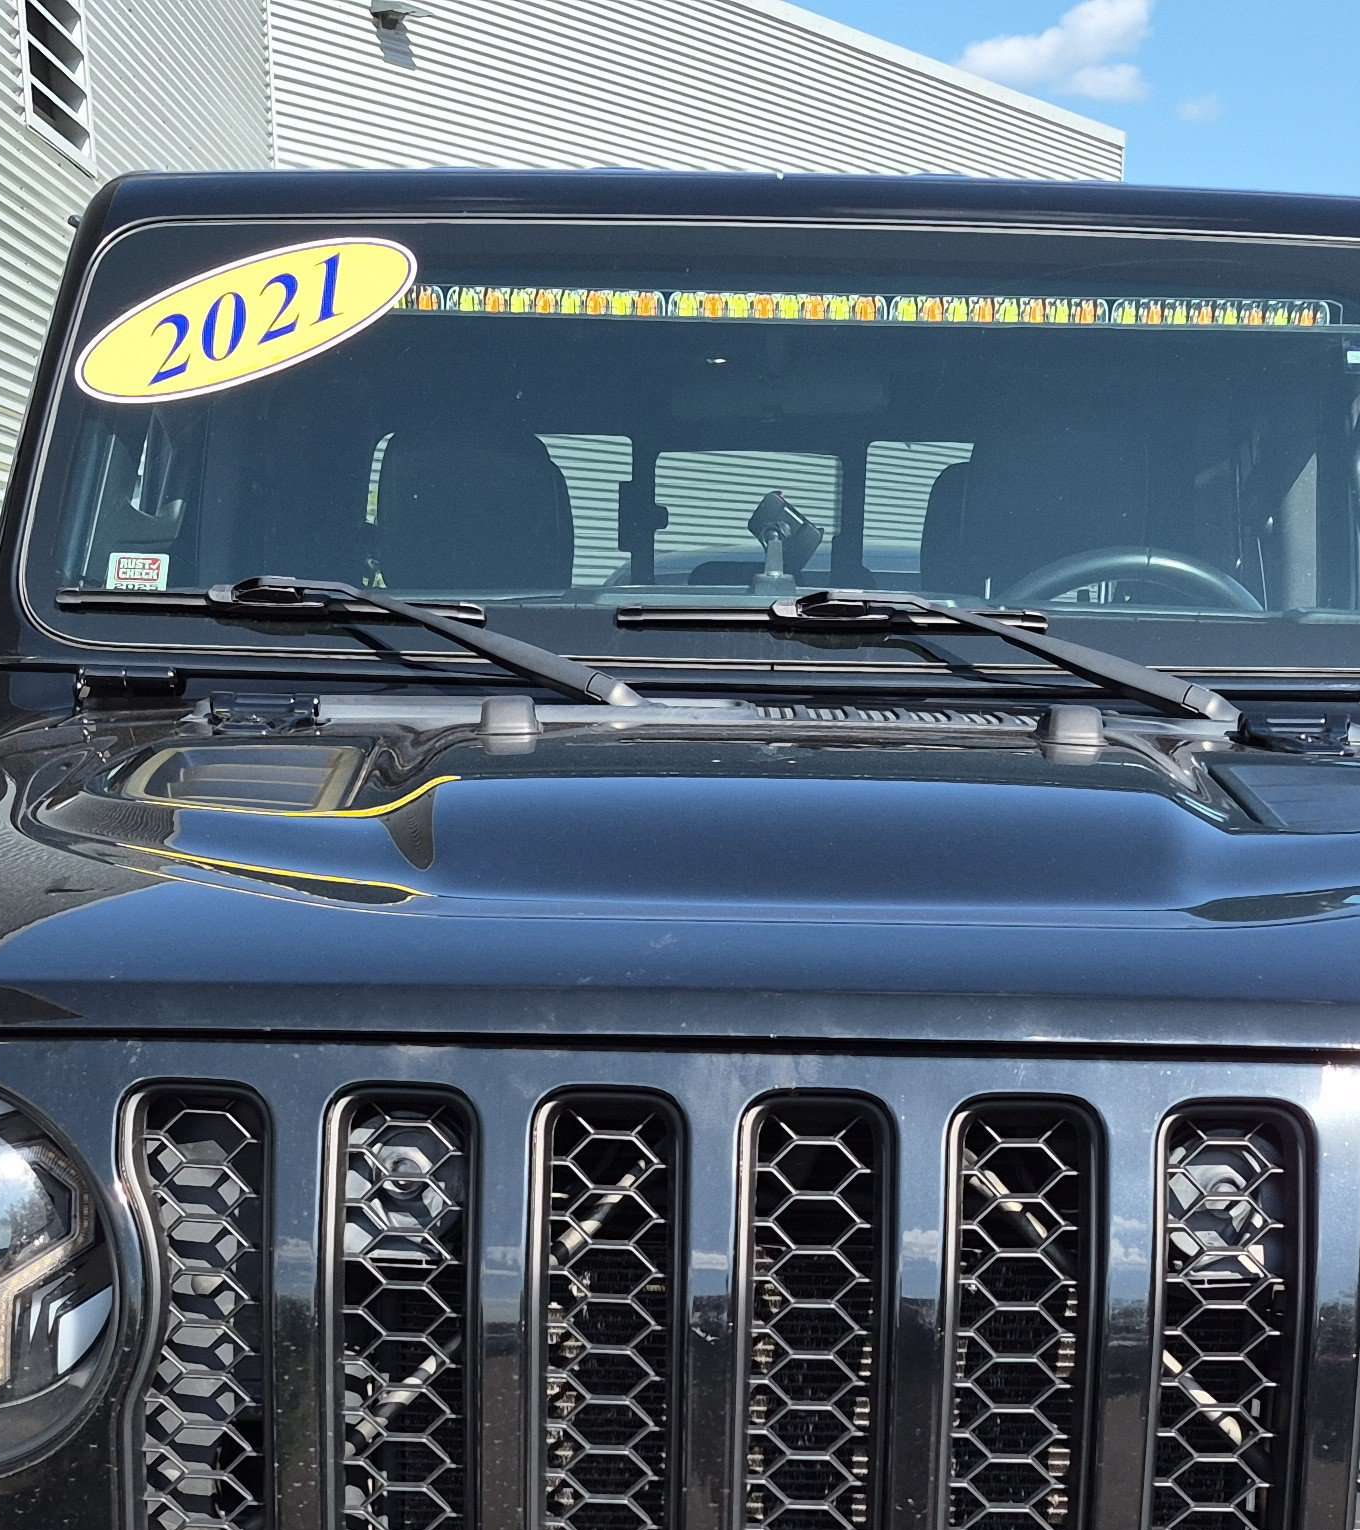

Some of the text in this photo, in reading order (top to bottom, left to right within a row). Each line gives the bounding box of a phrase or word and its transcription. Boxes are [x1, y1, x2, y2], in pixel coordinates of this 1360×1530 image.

[149, 253, 343, 386] 2021
[120, 559, 151, 569] RUST
[118, 569, 159, 580] CHECK
